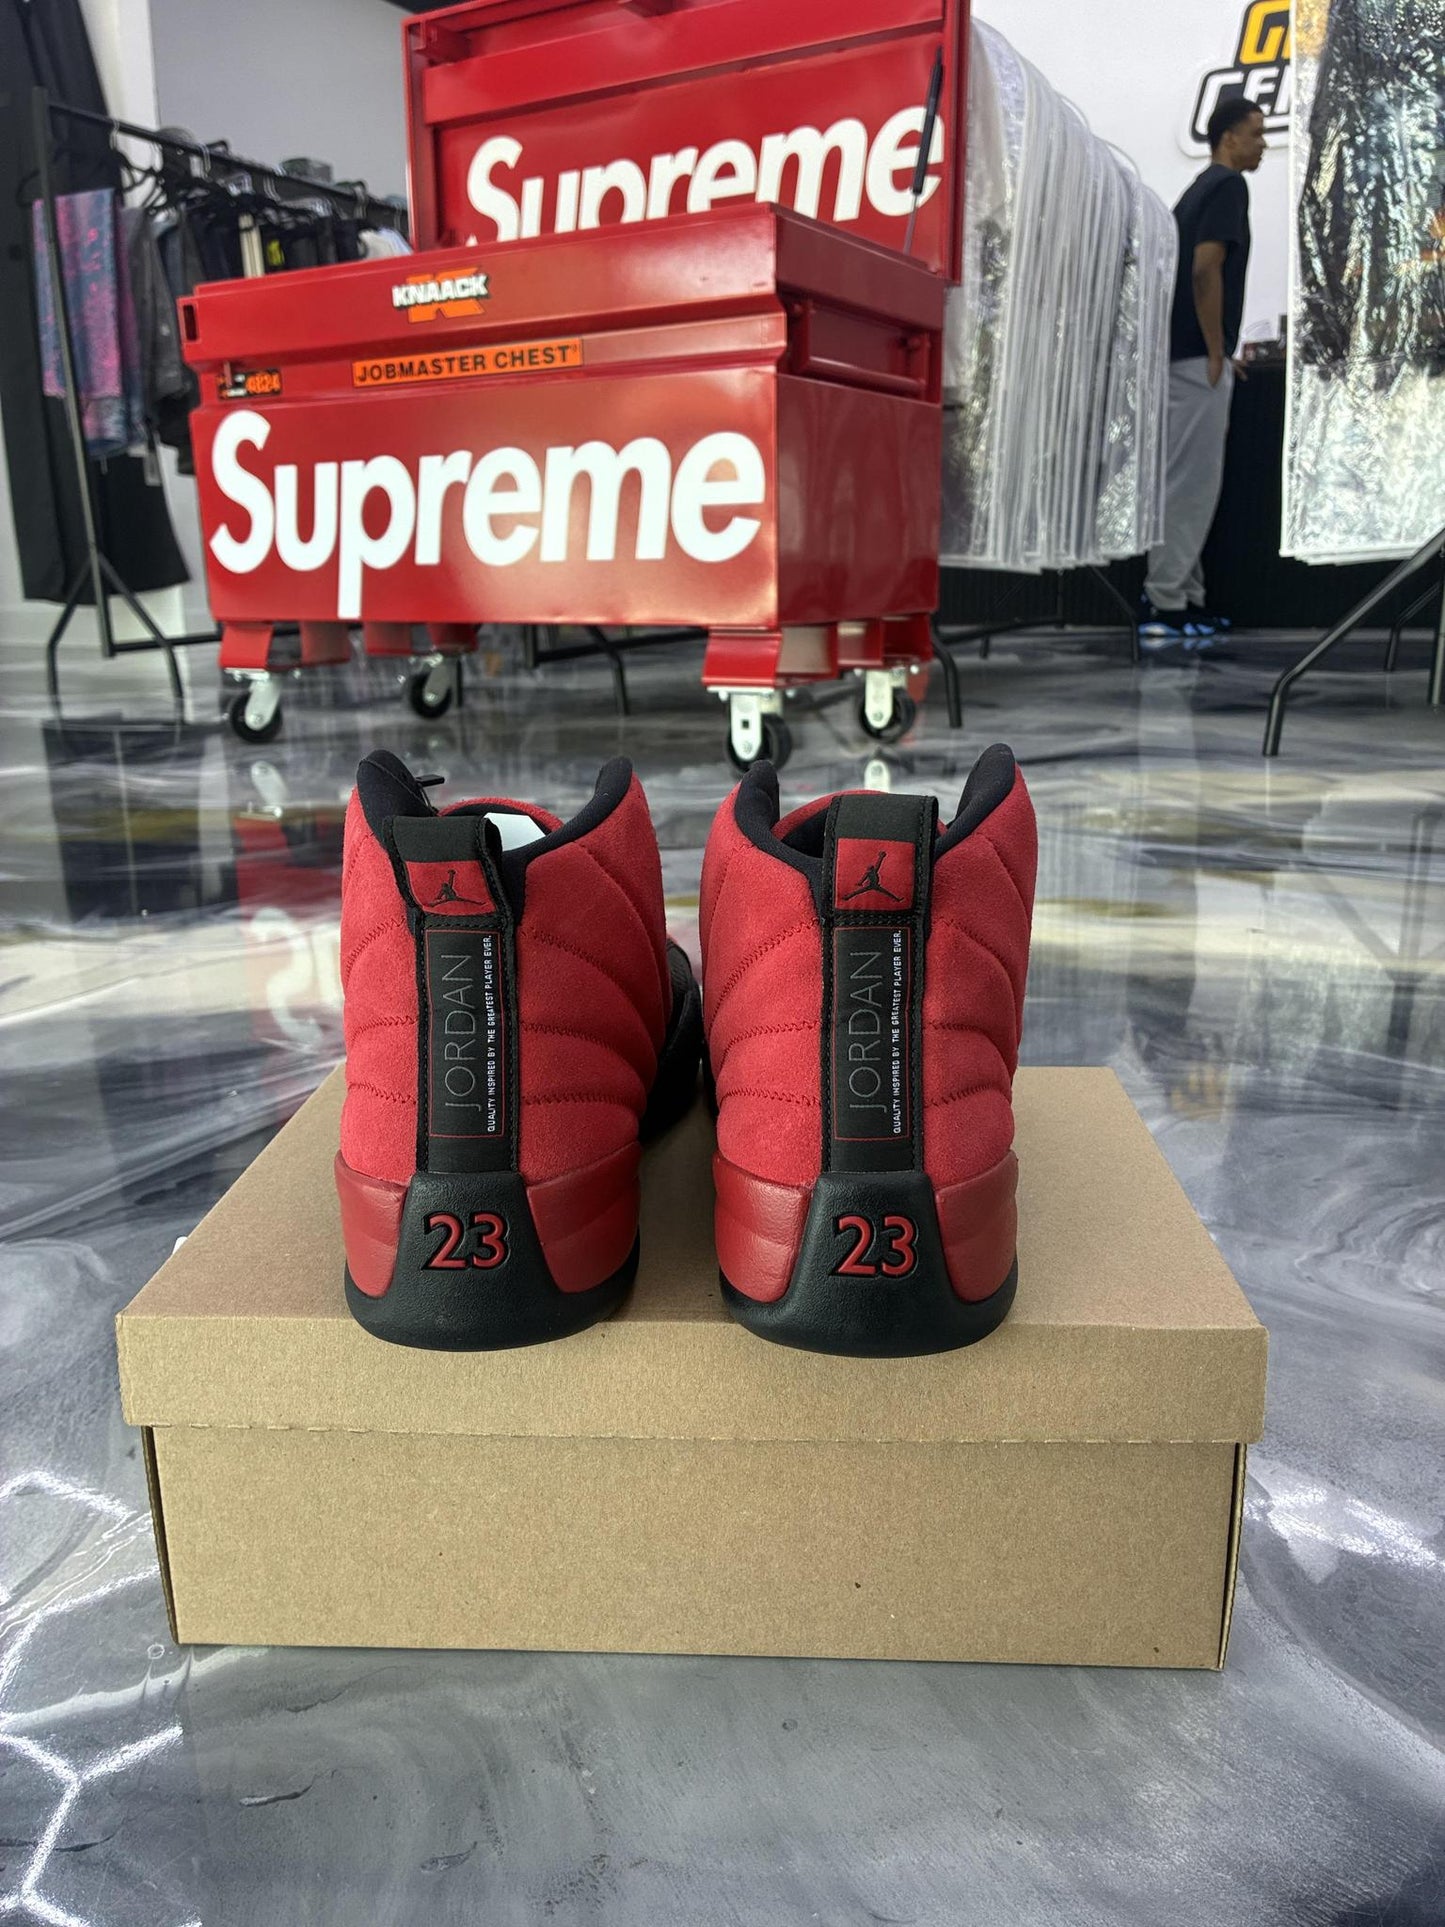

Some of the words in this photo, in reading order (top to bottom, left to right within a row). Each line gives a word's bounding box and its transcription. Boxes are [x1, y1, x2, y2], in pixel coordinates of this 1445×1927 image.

[1240, 0, 1290, 64] G
[391, 274, 489, 308] KNAACK
[358, 354, 487, 382] JOBMASTER
[494, 345, 571, 369] CHEST
[210, 410, 766, 619] Supreme
[483, 935, 492, 957] EVER.
[893, 930, 902, 953] EVER.
[484, 959, 493, 989] PLAYER
[893, 956, 902, 986] PLAYER
[485, 992, 496, 1027] GREATEST
[891, 989, 902, 1026] GREATEST
[441, 955, 482, 1112] JORDAN
[487, 1029, 496, 1043] THE
[849, 952, 887, 1113] JORDAN
[892, 1028, 900, 1042] THE
[487, 1047, 496, 1058] BY
[892, 1046, 900, 1057] BY
[487, 1060, 496, 1096] INSPIRED
[892, 1060, 901, 1096] INSPIRED
[487, 1098, 497, 1132] QUALITY
[892, 1099, 902, 1134] QUALITY
[422, 1212, 508, 1270] 23
[831, 1214, 917, 1276] 23
